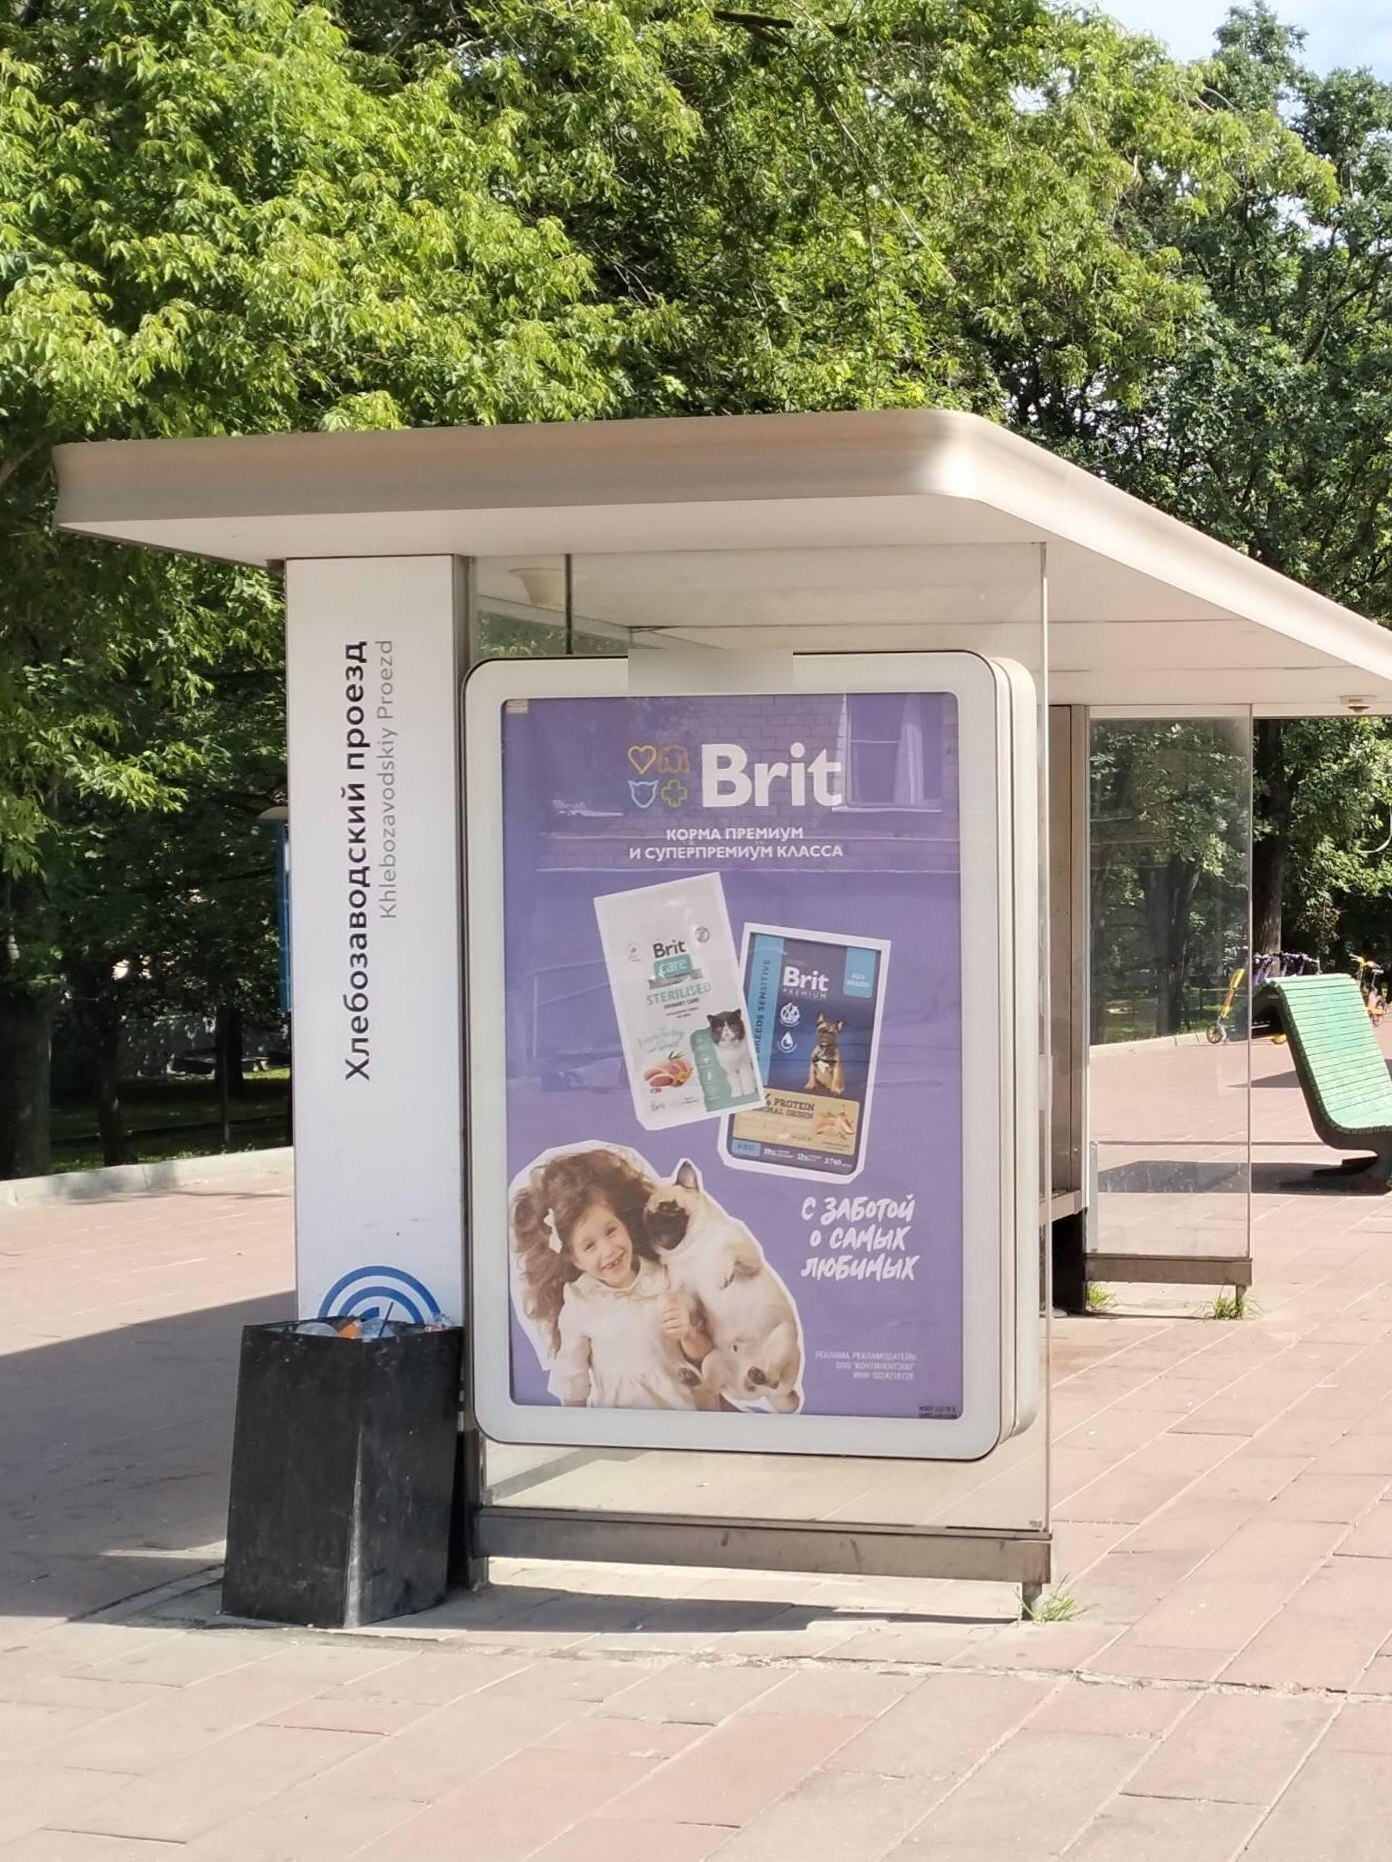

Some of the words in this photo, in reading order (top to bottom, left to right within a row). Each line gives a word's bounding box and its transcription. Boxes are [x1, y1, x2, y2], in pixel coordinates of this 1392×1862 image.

[374, 639, 396, 720] Proezd
[343, 641, 371, 769] проезд
[701, 742, 843, 808] Brit
[377, 725, 399, 919] Khlebozavodskiy
[666, 827, 722, 842] КОРМА
[725, 826, 805, 842] ПРЕМИУМ
[629, 847, 642, 860] И
[644, 845, 774, 861] СУПЕРПРЕМИУМ
[776, 844, 844, 859] КЛАССА
[341, 783, 371, 1082] Хлебозаводский
[652, 939, 687, 959] Brit
[659, 959, 689, 977] care
[782, 965, 830, 992] Brit
[646, 982, 712, 1006] STERILISED
[758, 959, 771, 1011] SENSITIVE
[782, 987, 828, 999] PREMIUM
[772, 1097, 816, 1112] PROTEIN
[801, 1196, 817, 1221] С
[820, 1193, 916, 1226] ЗАБОТОЙ
[829, 1223, 913, 1253] САМЫХ
[801, 1253, 920, 1282] ЛЮБИМЫХ
